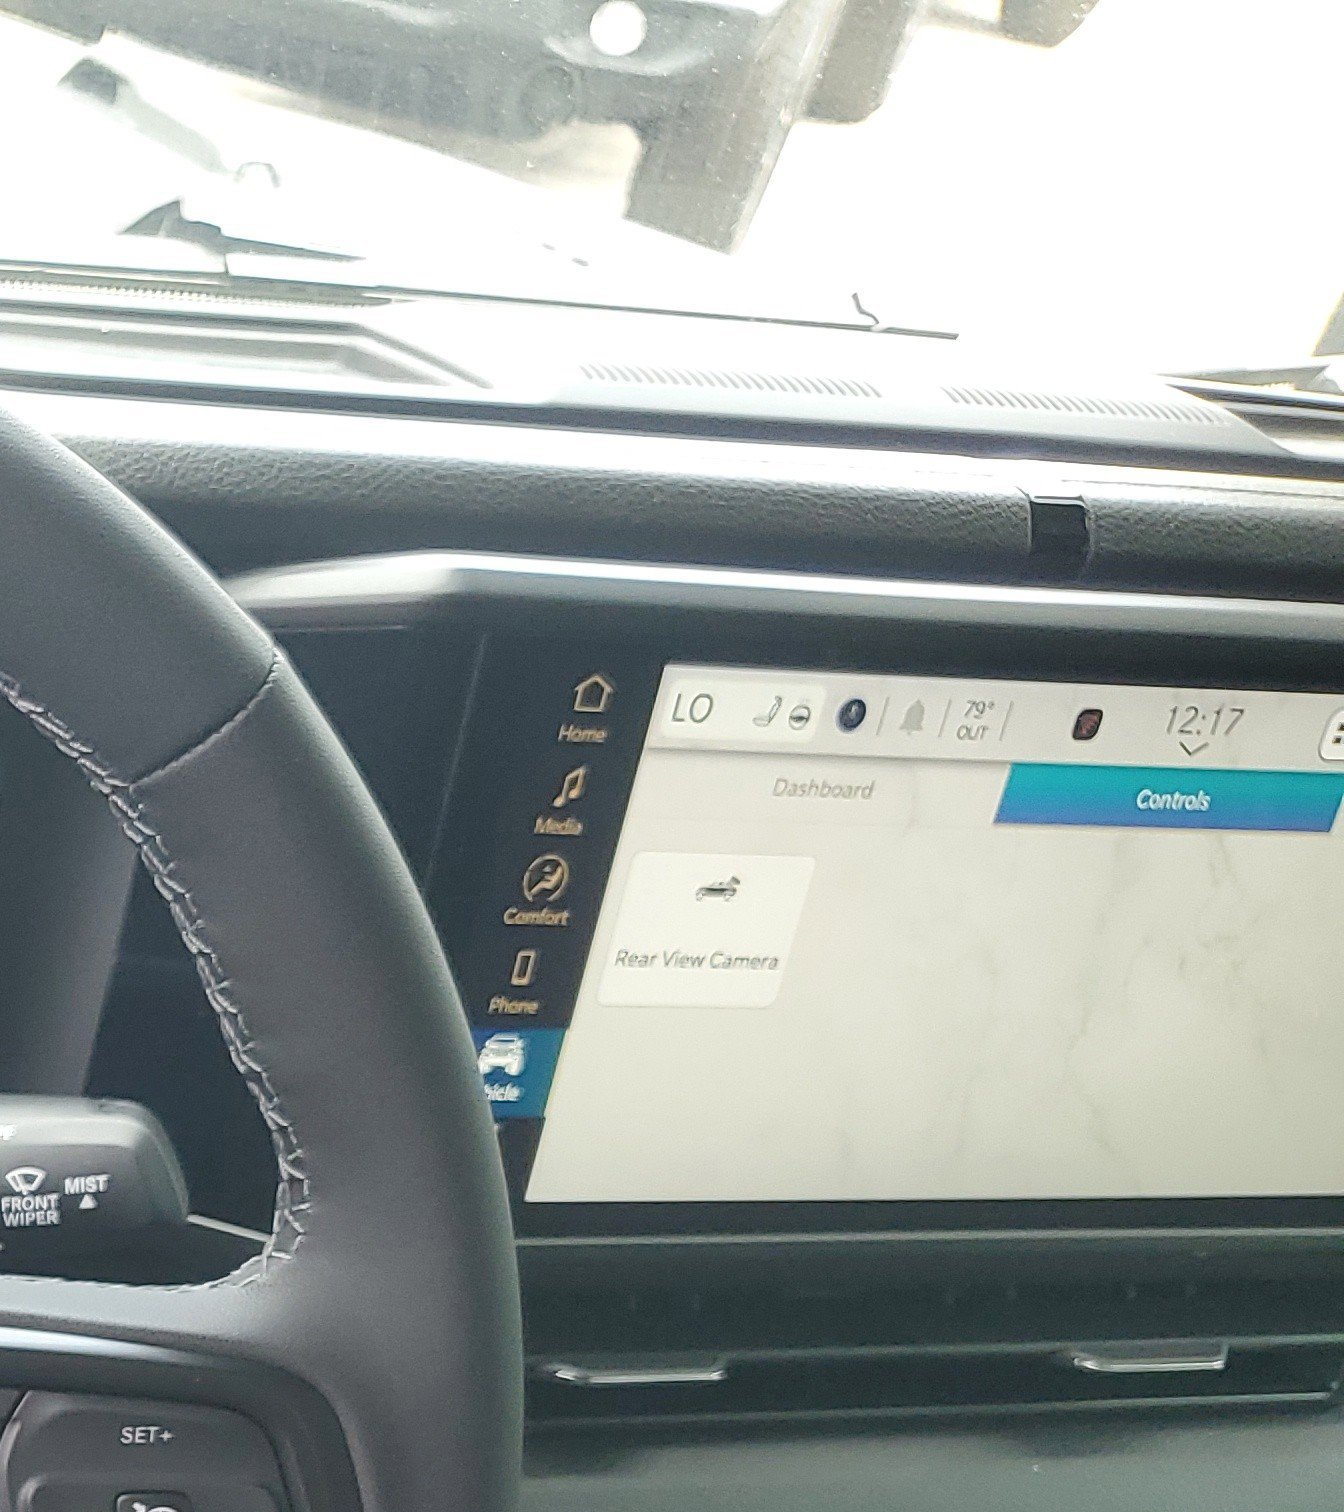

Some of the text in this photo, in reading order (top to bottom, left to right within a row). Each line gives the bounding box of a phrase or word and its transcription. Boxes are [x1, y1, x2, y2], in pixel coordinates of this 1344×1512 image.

[670, 692, 714, 724] LO
[964, 698, 996, 720] 79°
[1166, 704, 1246, 737] 12:17
[558, 723, 609, 743] Home
[956, 724, 989, 742] OUT
[772, 776, 876, 801] Dashboard
[1135, 787, 1212, 812] Controls
[533, 815, 584, 836] Media
[503, 906, 570, 927] Comfort
[615, 948, 780, 970] Rear View Camera
[488, 994, 540, 1015] Phone
[64, 1173, 112, 1195] MIST
[1, 1192, 62, 1213] FRONT
[2, 1210, 62, 1227] WIPER
